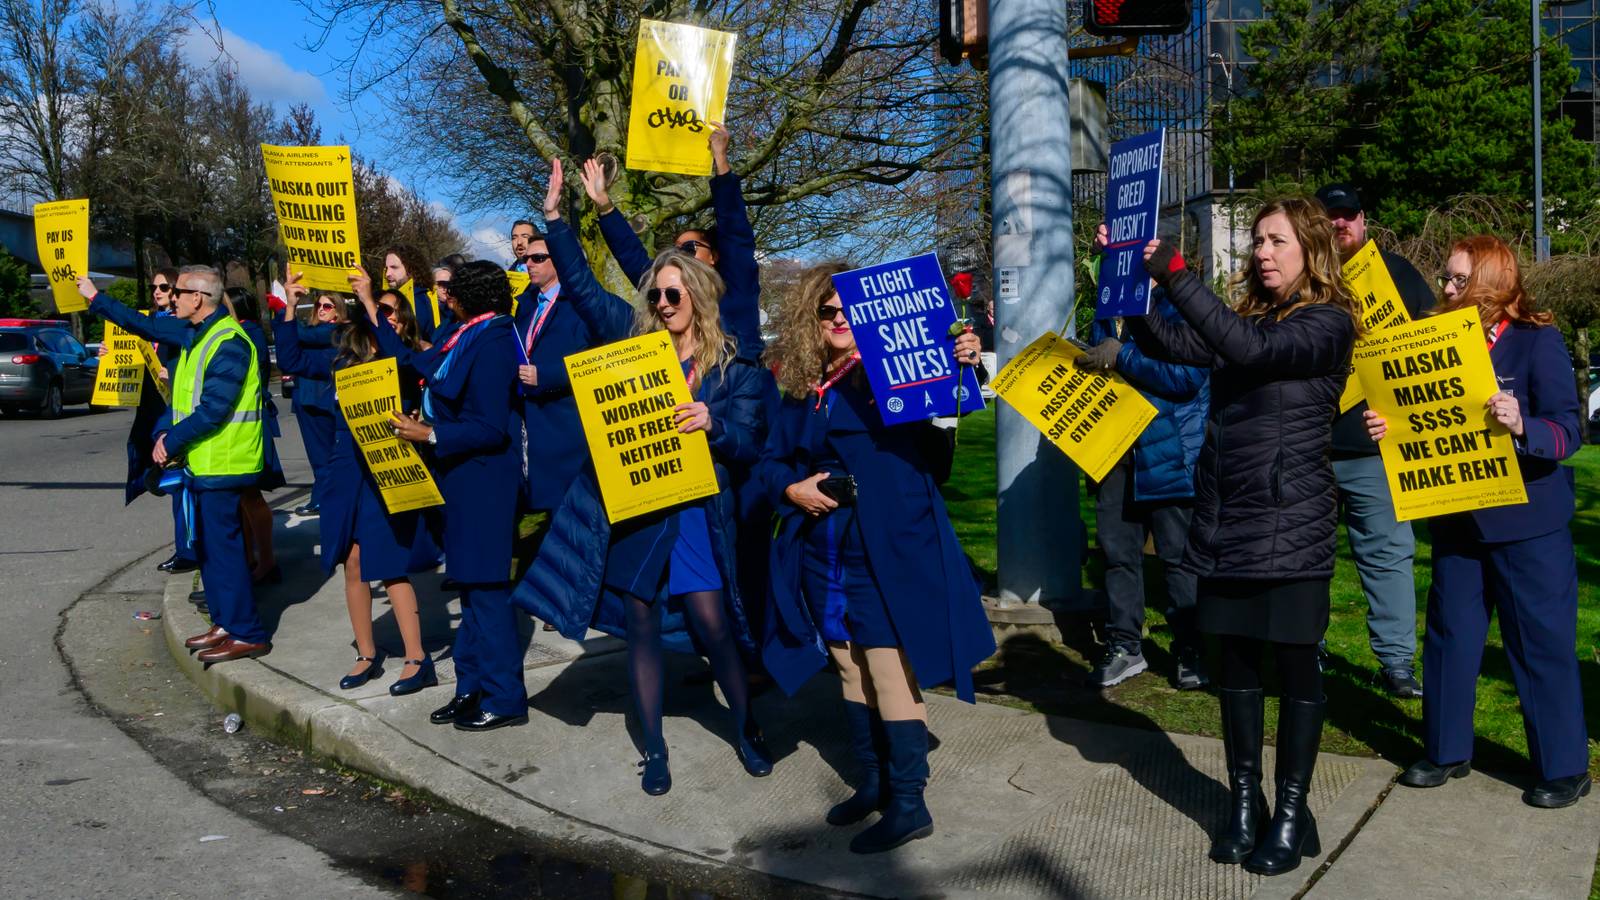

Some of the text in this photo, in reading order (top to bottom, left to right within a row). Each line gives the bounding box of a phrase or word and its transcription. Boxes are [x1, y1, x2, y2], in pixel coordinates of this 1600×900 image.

[668, 84, 688, 101] OR
[648, 107, 704, 132] CHAOS
[1111, 142, 1160, 181] CORPORATE
[271, 178, 348, 198] ALASKA QUIT
[1117, 180, 1145, 210] GREED
[279, 200, 345, 221] STALLING
[46, 229, 73, 244] PAY US
[284, 225, 346, 244] OUR PAY IS
[1110, 212, 1148, 244] DOESN'T
[55, 248, 65, 260] OR
[1117, 249, 1133, 277] FLY
[860, 267, 916, 298] FLIGHT
[849, 287, 944, 326] ATTENDANTS
[1364, 291, 1377, 309] IN
[1364, 299, 1395, 329] ENGER
[114, 340, 136, 350] MAKES
[878, 317, 935, 353] SAVE
[1354, 331, 1458, 360] FLIGHT ATTENDANTS
[1392, 325, 1438, 342] AIRLINES
[570, 344, 641, 369] ALASKA AIRLINES
[573, 350, 658, 379] FLIGHT ATTENDANTS
[882, 347, 952, 386] LIVES!
[1382, 346, 1462, 381] ALASKA
[99, 382, 140, 392] MAKE RENT
[105, 368, 138, 378] WE CAN'T
[593, 368, 671, 404] DON'T LIKE
[995, 368, 1014, 390] ALASKA
[1000, 376, 1018, 395] FLIGHT
[1037, 364, 1068, 395] 1ST IN
[1040, 369, 1089, 421] PASSENGE
[1393, 376, 1465, 407] MAKES
[344, 395, 396, 420] ALASKA QUIT
[602, 391, 676, 425] WORKING
[1070, 388, 1119, 444] 6TH IN PAY
[1408, 405, 1467, 434] $$$$
[355, 420, 395, 444] STALLIN
[607, 414, 681, 448] FOR FREE?
[1398, 429, 1492, 462] WE CAN'T
[366, 443, 411, 465] OUR PAY IS
[620, 436, 682, 467] NEITHER
[629, 458, 683, 487] DO WE!
[1398, 457, 1509, 492] MAKE RENT
